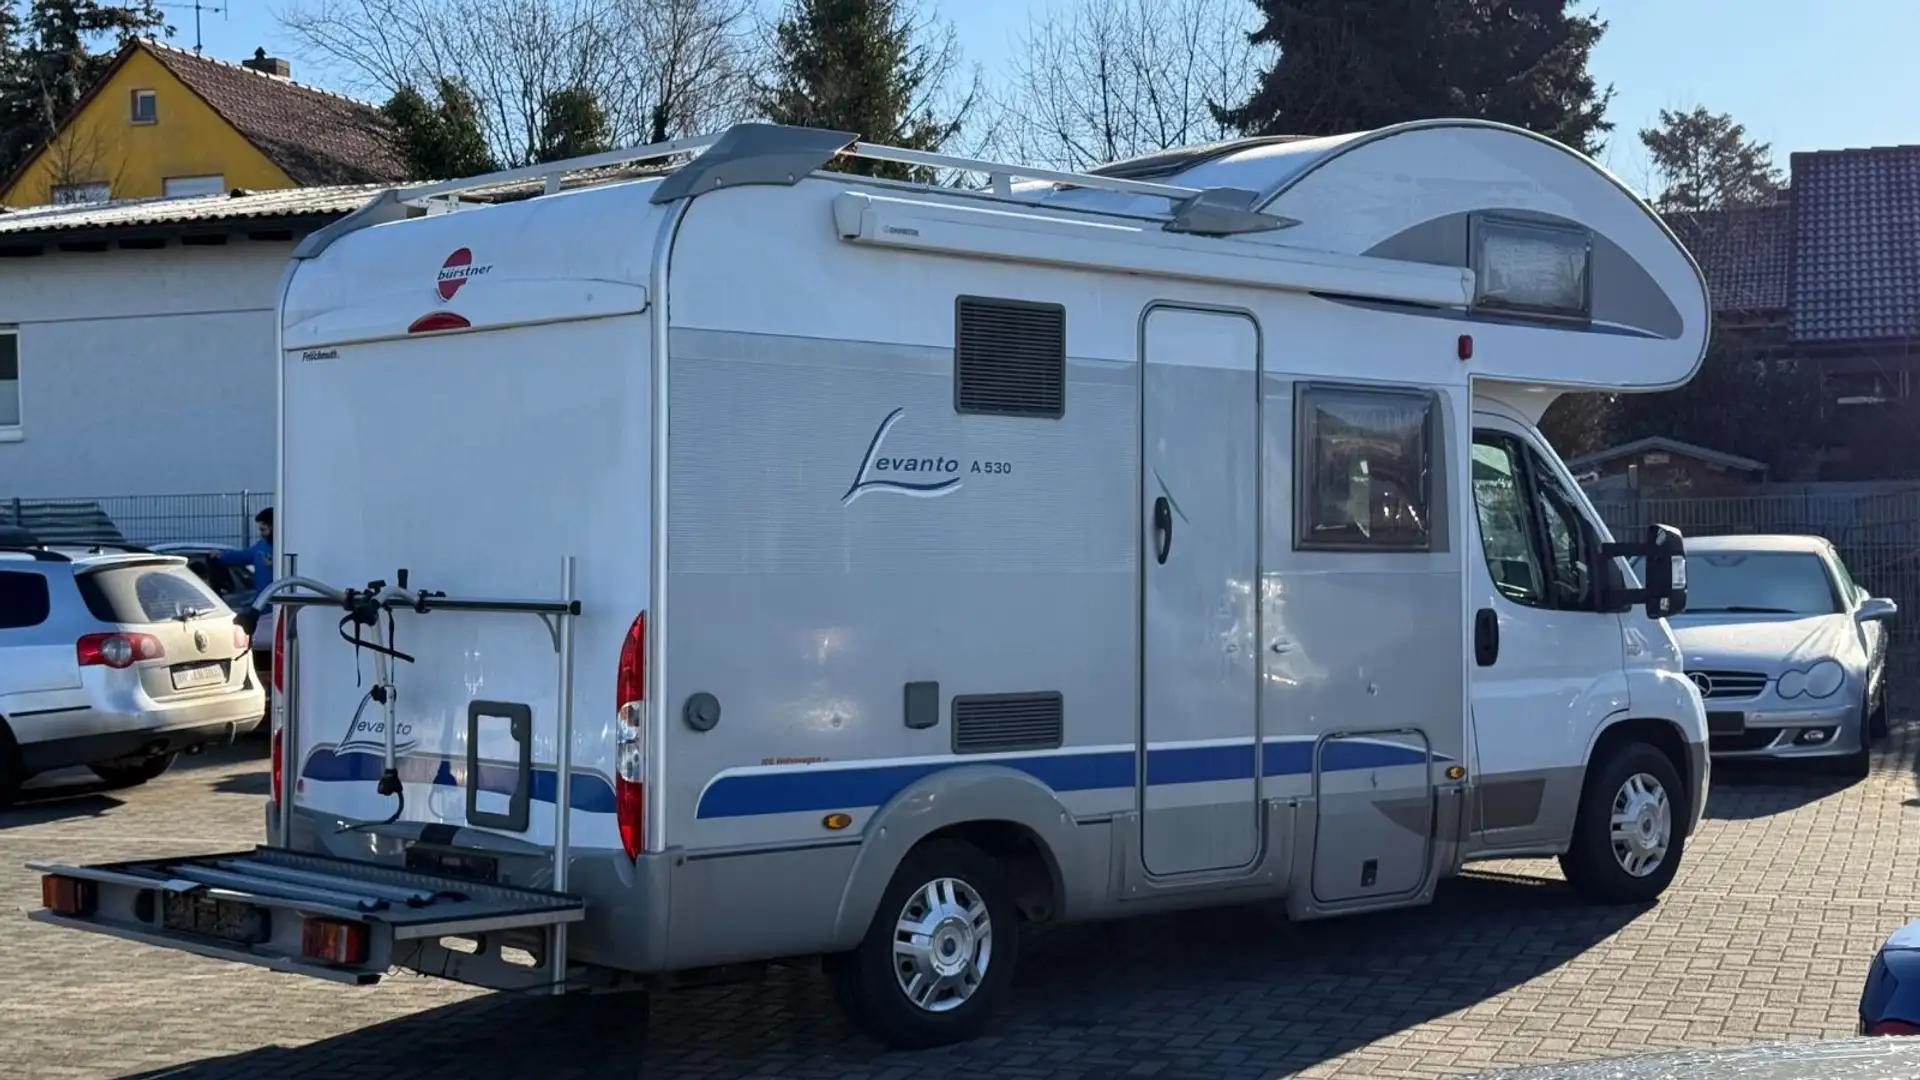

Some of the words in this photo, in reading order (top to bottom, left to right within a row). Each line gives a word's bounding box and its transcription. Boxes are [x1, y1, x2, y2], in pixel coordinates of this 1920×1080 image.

[437, 264, 493, 280] bürstner
[841, 407, 961, 502] Levanto
[970, 461, 981, 474] A
[984, 461, 1012, 475] 530
